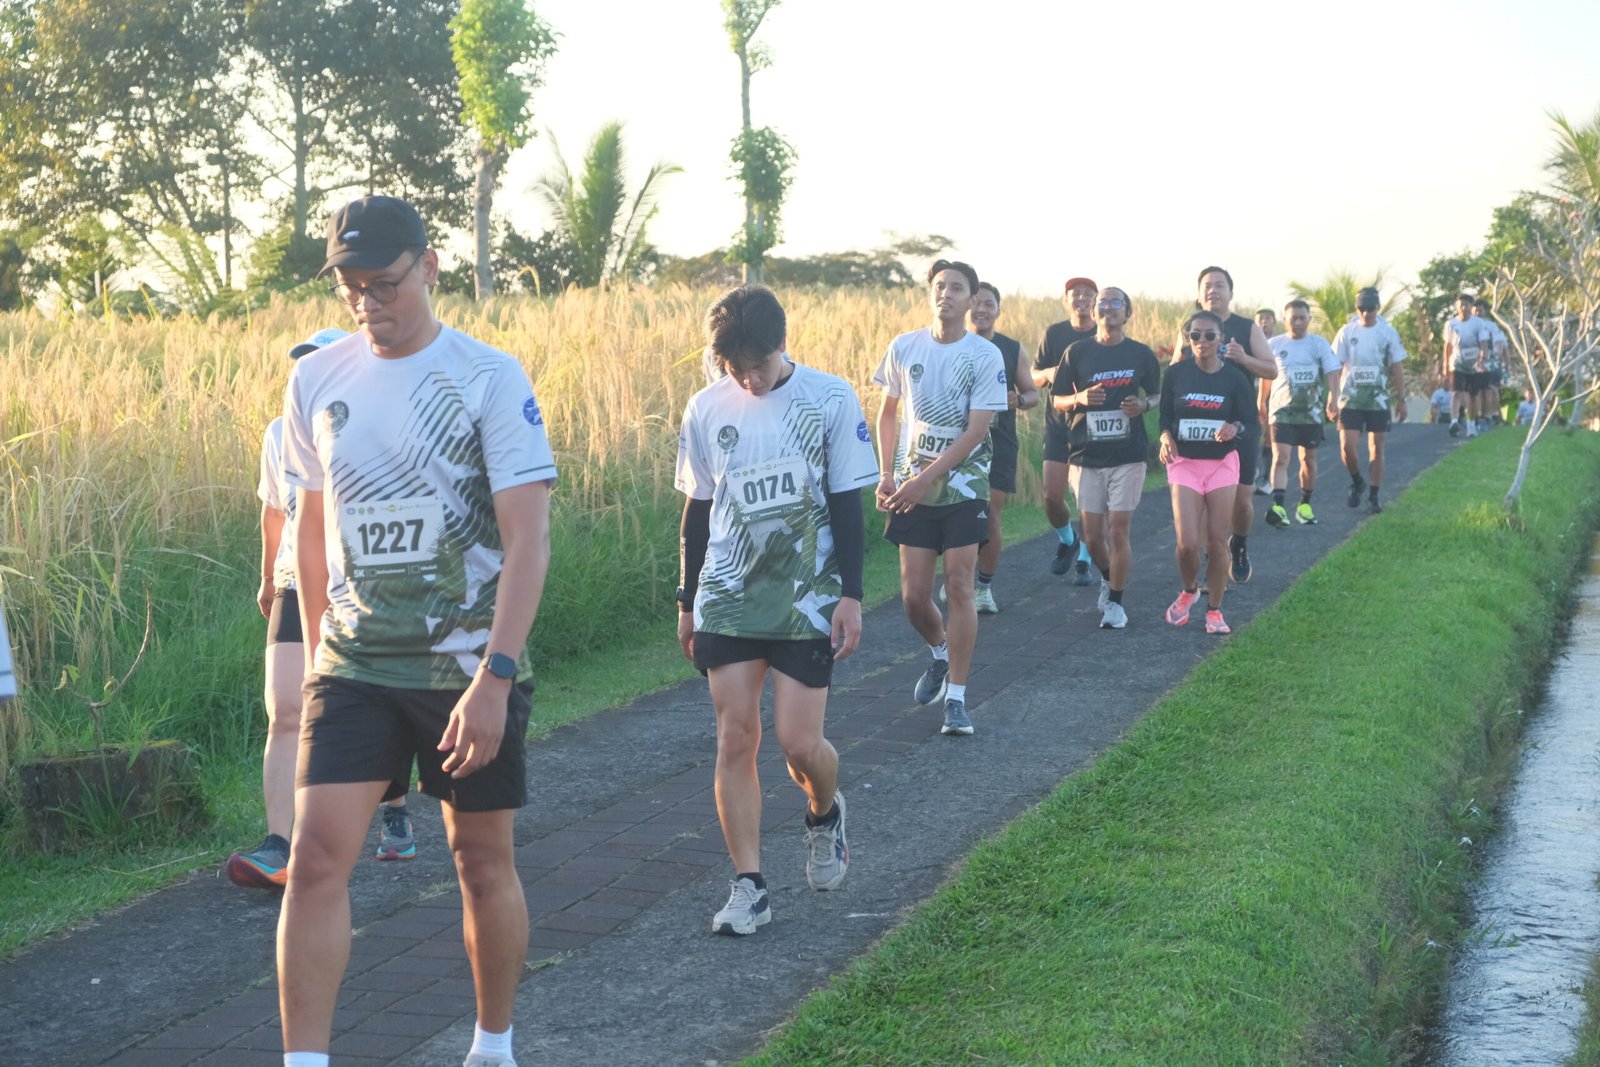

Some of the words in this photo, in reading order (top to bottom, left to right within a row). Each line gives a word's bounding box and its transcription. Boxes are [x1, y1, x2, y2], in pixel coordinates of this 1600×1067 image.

[1092, 369, 1135, 381] NEWS
[1294, 371, 1314, 380] 1225
[1185, 393, 1225, 403] NEWS
[1188, 400, 1222, 409] RUN
[1094, 418, 1123, 432] 1073
[742, 472, 796, 505] 0174
[741, 515, 751, 523] 5K
[357, 518, 424, 555] 1227
[353, 568, 366, 578] 5K
